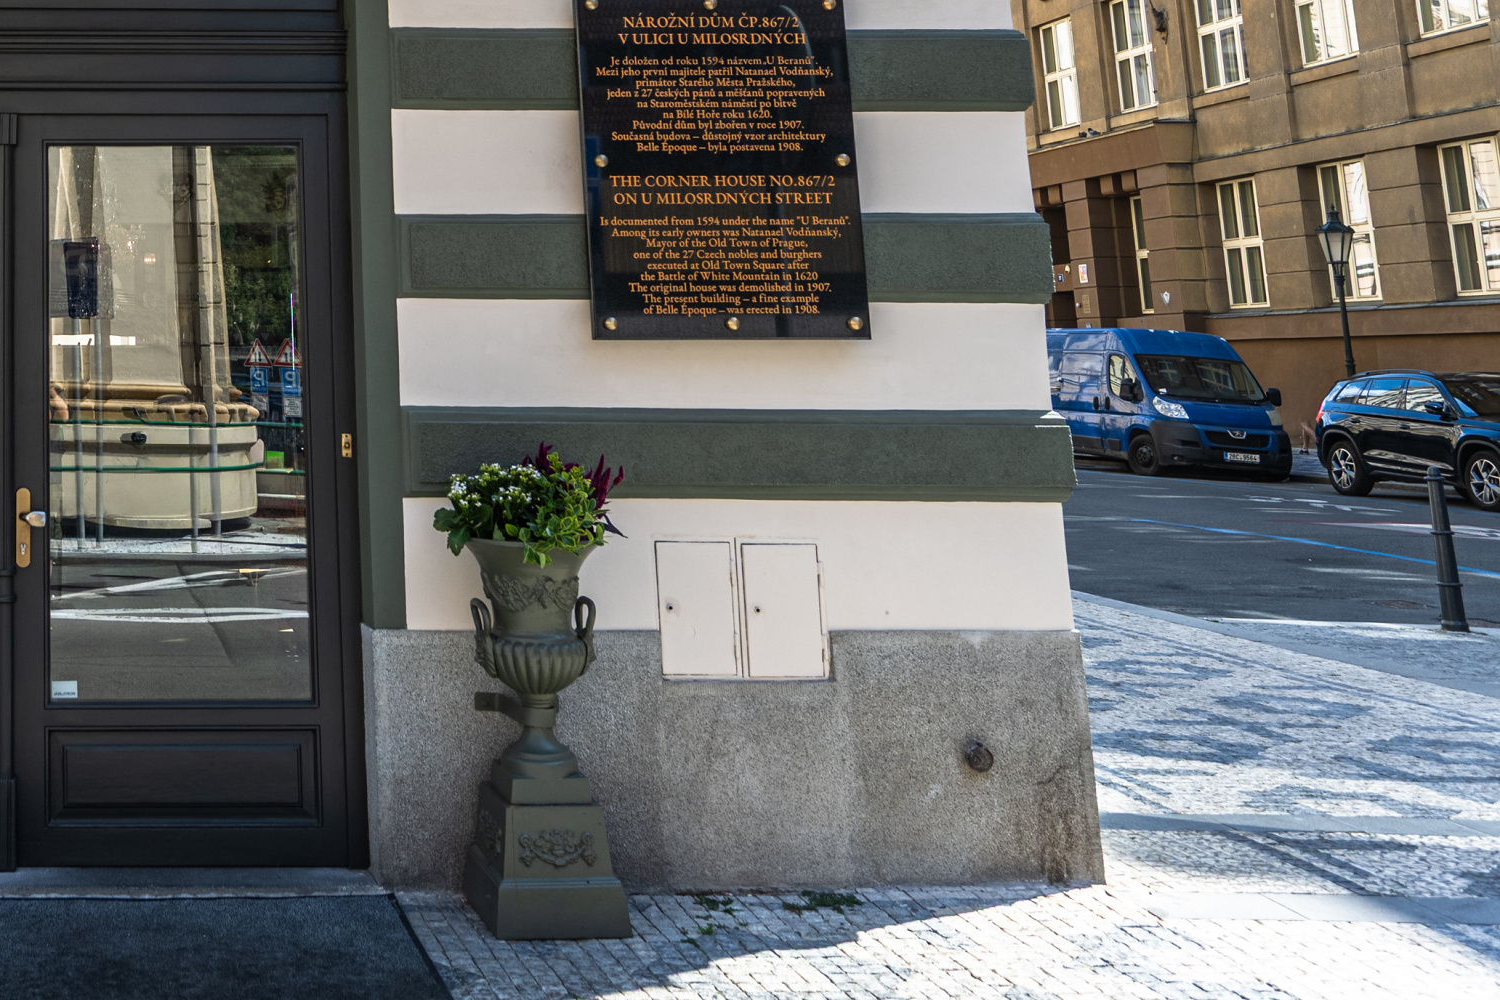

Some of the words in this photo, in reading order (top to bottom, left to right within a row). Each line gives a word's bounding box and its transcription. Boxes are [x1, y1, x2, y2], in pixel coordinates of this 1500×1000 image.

[622, 13, 696, 28] NÁROŽNÍ
[698, 13, 735, 28] DŮM
[738, 13, 800, 28] ČP.867/2
[618, 33, 629, 44] V
[632, 33, 675, 44] ULICI
[677, 33, 689, 44] U
[692, 30, 807, 44] MILOSRDNÝCH
[610, 55, 621, 68] Je
[622, 55, 660, 65] doložen
[661, 55, 674, 65] od
[677, 55, 700, 65] roku
[701, 55, 726, 65] 1594
[726, 55, 762, 65] názvem
[762, 55, 776, 65] „U
[777, 55, 819, 65] Beranů".
[596, 65, 620, 76] Mezi
[620, 65, 642, 79] jeho
[642, 65, 669, 79] první
[669, 65, 707, 79] majitele
[708, 65, 734, 79] patřil
[735, 65, 778, 76] Natanael
[778, 65, 835, 79] Vodňanský,
[635, 76, 678, 90] primátor
[678, 76, 715, 87] Starého
[716, 76, 745, 87] Města
[746, 76, 797, 90] Pražského,
[606, 87, 633, 101] jeden
[633, 90, 640, 98] z
[640, 87, 653, 98] 27
[654, 87, 691, 101] českých
[692, 87, 717, 101] pánů
[717, 89, 724, 98] a
[725, 87, 765, 98] měšťanů
[766, 87, 827, 101] popravených
[649, 98, 720, 108] Staroměstském
[721, 98, 758, 108] náměstí
[759, 101, 773, 111] po
[773, 98, 798, 108] bitvě
[662, 111, 675, 119] na
[675, 108, 695, 119] Bílé
[696, 108, 721, 119] Hoře
[722, 108, 746, 119] roku
[747, 108, 773, 119] 1620.
[632, 119, 674, 129] Původní
[674, 119, 697, 129] dům
[697, 119, 714, 132] byl
[714, 119, 748, 129] zbořen
[778, 119, 806, 129] 1907.
[611, 130, 655, 140] Současná
[656, 130, 692, 140] budova
[701, 130, 744, 143] důstojný
[767, 130, 827, 143] architektury
[636, 141, 660, 151] Belle
[661, 139, 698, 154] Époque
[707, 141, 729, 154] byla
[729, 141, 776, 154] postavena
[777, 141, 805, 151] 1908.
[609, 175, 642, 187] THE
[644, 175, 713, 187] CORNER
[714, 175, 767, 187] HOUSE
[769, 175, 837, 187] NO.867/2
[613, 192, 638, 205] ON
[641, 192, 653, 205] U
[656, 189, 773, 205] MILOSRDNÝCH
[775, 192, 834, 205] STREET
[599, 215, 610, 225] Is
[610, 215, 670, 225] documented
[670, 215, 695, 225] from
[696, 215, 721, 225] 1594
[721, 215, 751, 225] under
[751, 215, 768, 225] the
[796, 215, 811, 225] "U
[812, 215, 851, 225] Beranů".
[611, 226, 647, 240] Among
[647, 226, 661, 237] its
[661, 226, 685, 240] early
[686, 229, 722, 237] owners
[722, 229, 741, 237] was
[742, 226, 785, 237] Natanael
[785, 226, 843, 240] Vodňanský,
[645, 237, 678, 251] Mayor
[678, 237, 691, 248] of
[690, 237, 707, 248] the
[708, 237, 728, 248] Old
[729, 237, 759, 248] Town
[759, 237, 772, 248] of
[772, 237, 809, 251] Prague,
[633, 251, 652, 259] one
[652, 248, 664, 259] of
[664, 248, 681, 259] the
[681, 248, 695, 259] 27
[696, 248, 727, 259] Czech
[727, 248, 759, 259] nobles
[759, 248, 779, 259] and
[779, 248, 823, 262] burghers
[646, 259, 689, 270] executed
[689, 261, 700, 270] at
[701, 259, 721, 270] Old
[722, 259, 752, 270] Town
[752, 259, 786, 273] Square
[786, 259, 810, 270] after
[640, 270, 656, 281] the
[657, 270, 686, 281] Battle
[687, 270, 699, 281] of
[700, 270, 731, 281] White
[732, 270, 781, 281] Mountain
[781, 270, 793, 281] in
[794, 270, 820, 281] 1620
[628, 281, 649, 292] The
[649, 281, 688, 295] original
[689, 281, 718, 292] house
[718, 284, 738, 292] was
[738, 281, 793, 292] demolished
[793, 281, 805, 292] in
[806, 281, 833, 292] 1907.
[642, 292, 663, 303] The
[663, 292, 699, 306] present
[699, 292, 742, 306] building
[751, 294, 758, 303] a
[758, 292, 779, 303] fine
[779, 292, 820, 306] example
[642, 303, 655, 314] of
[655, 303, 679, 314] Belle
[680, 301, 718, 317] Époque
[726, 306, 745, 314] was
[745, 303, 781, 314] erected
[781, 303, 793, 314] in
[794, 303, 821, 314] 1908.
